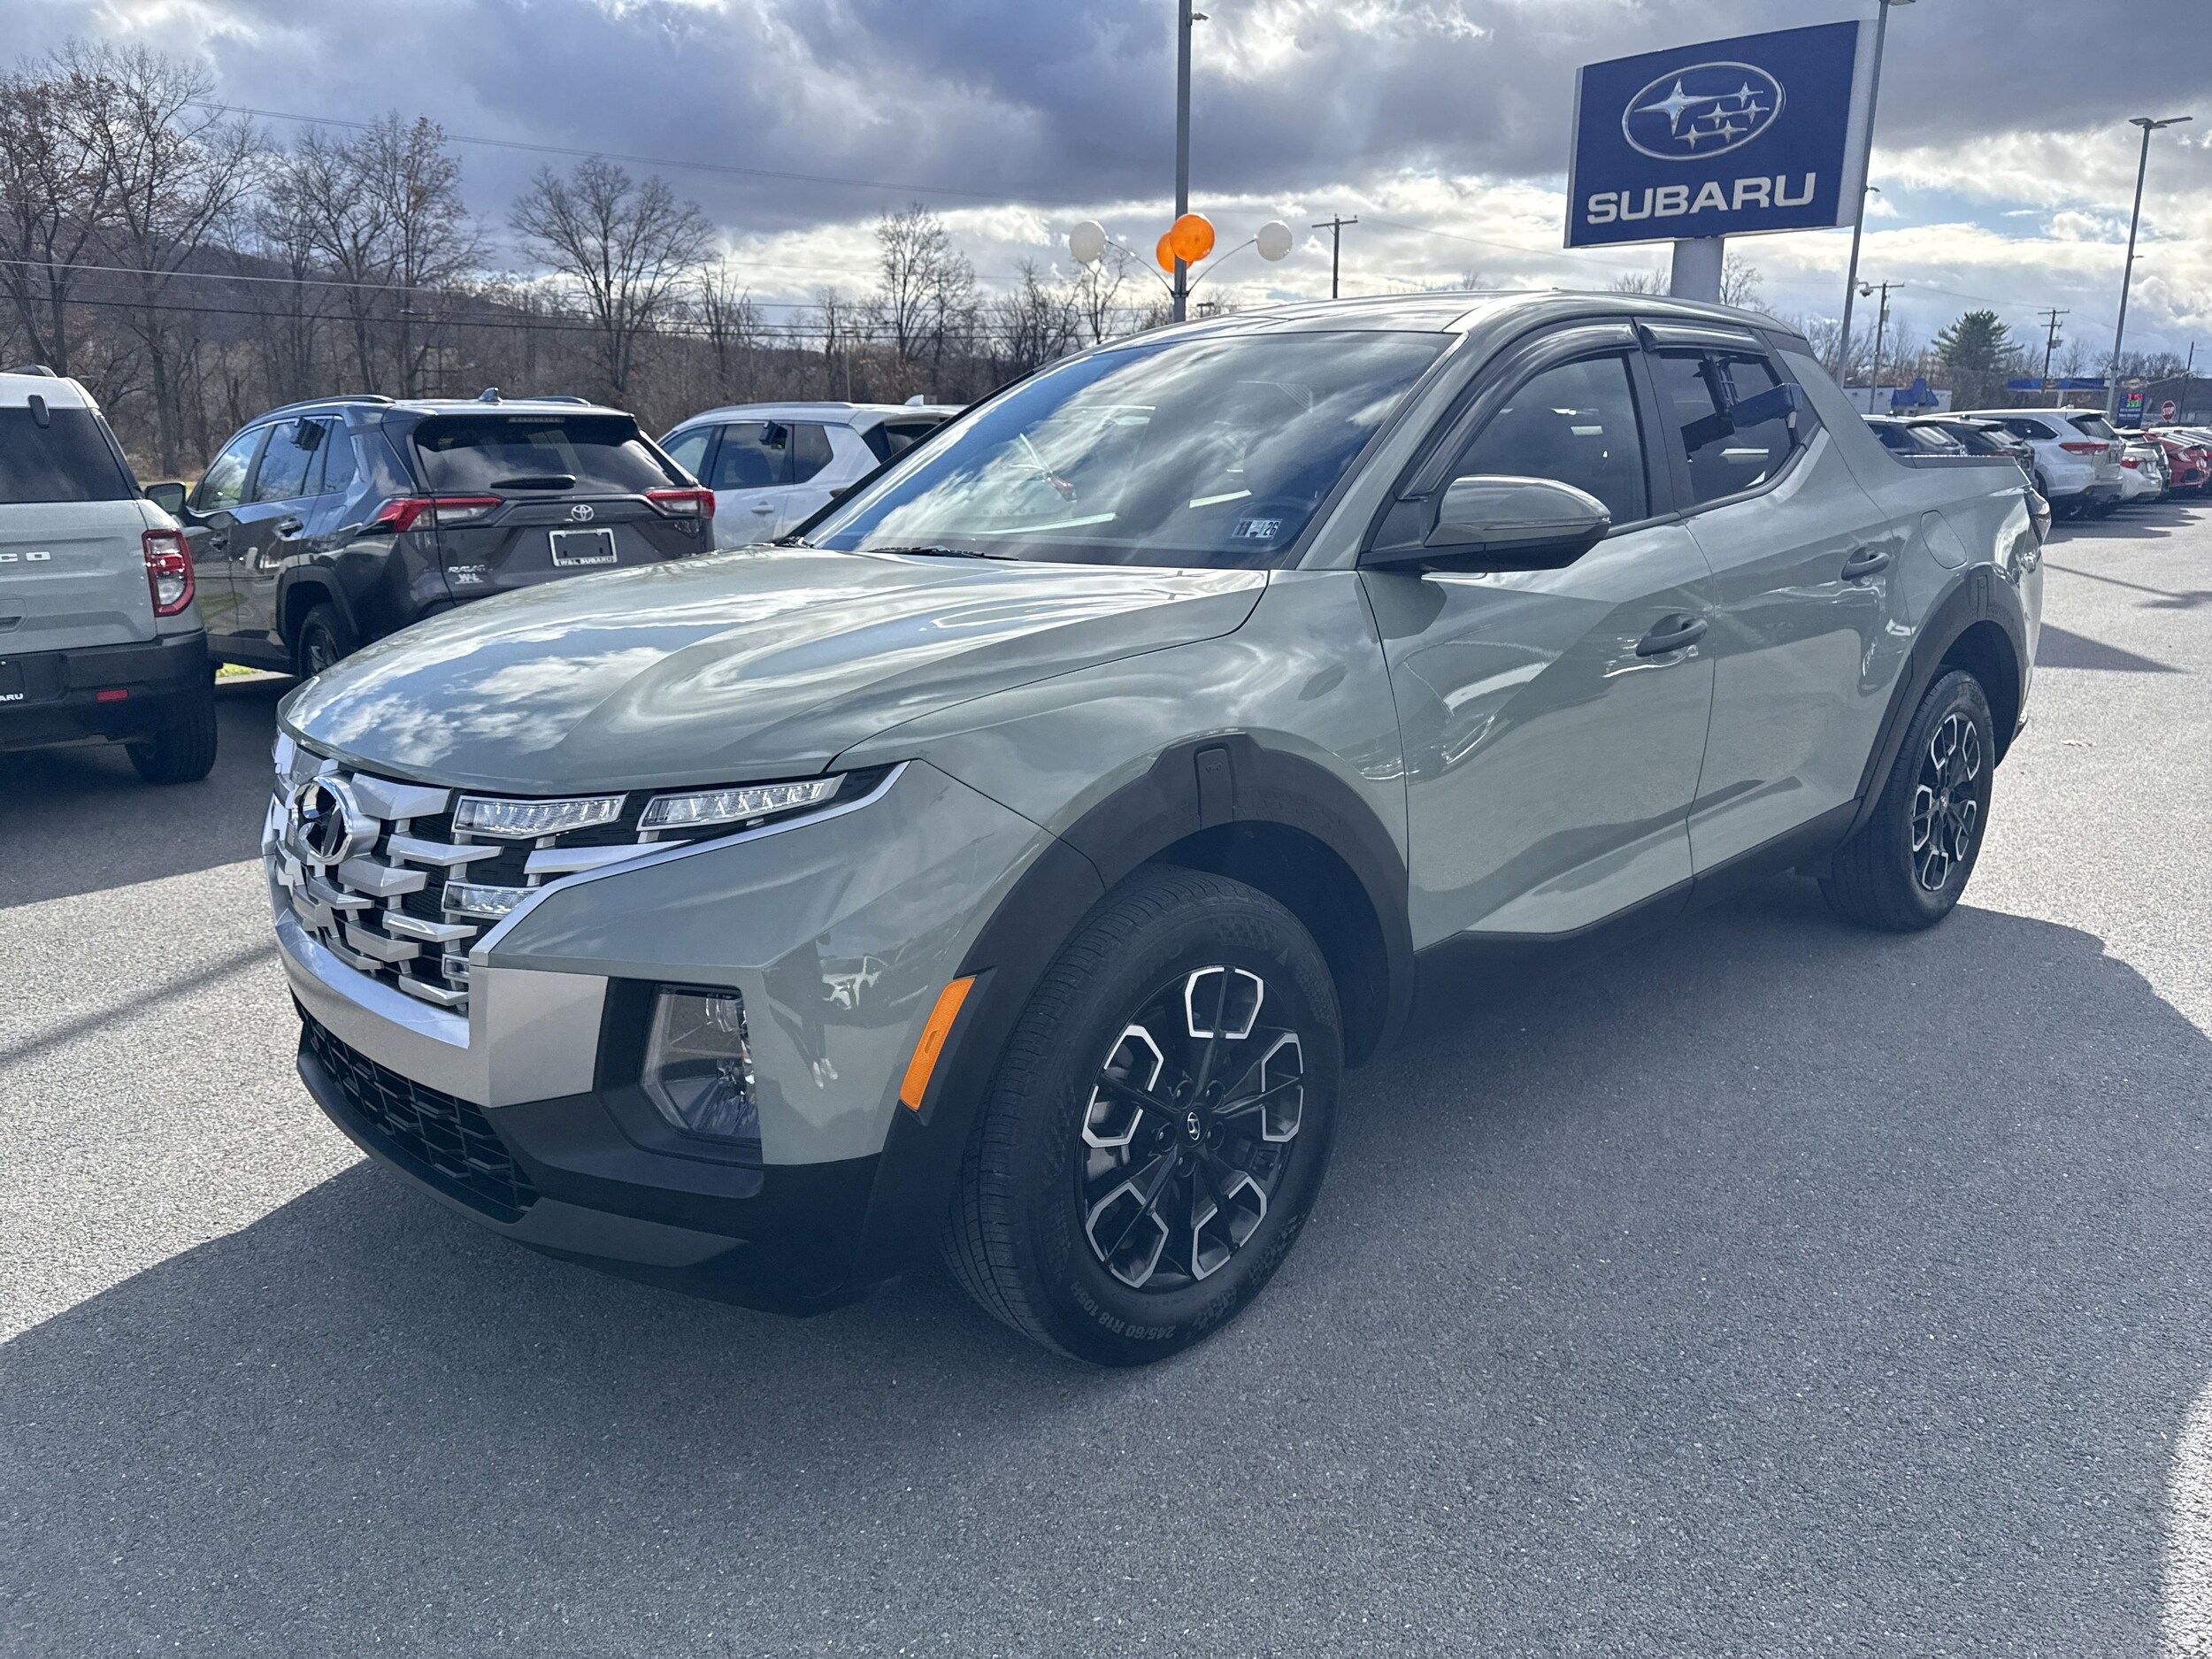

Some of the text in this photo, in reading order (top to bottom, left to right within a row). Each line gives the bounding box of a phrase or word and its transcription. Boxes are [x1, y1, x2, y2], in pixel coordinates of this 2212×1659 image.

[1586, 173, 1816, 225] SUBARU
[2162, 406, 2175, 416] STOP
[1263, 521, 1279, 536] 26
[0, 551, 51, 562] CO
[580, 556, 613, 565] SUBARU
[1069, 1280, 1176, 1340] 245/60 R18 105H
